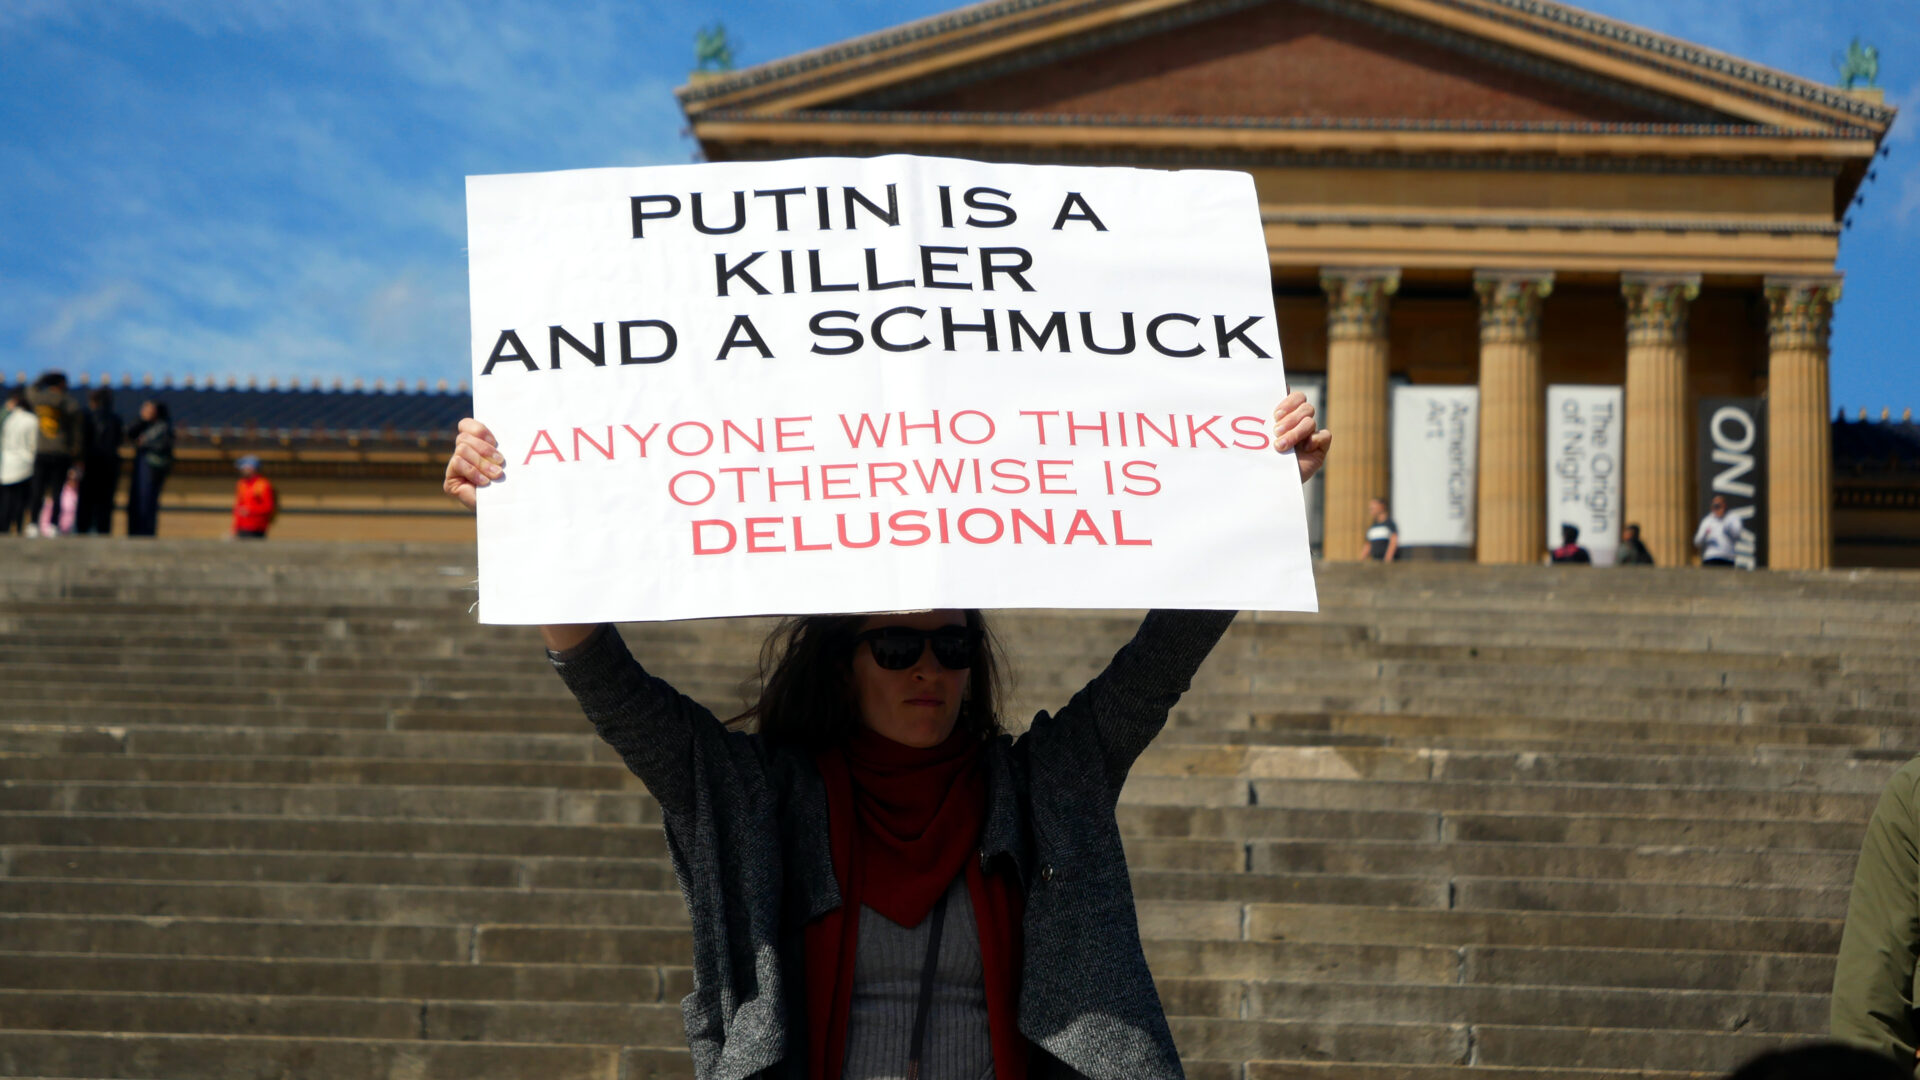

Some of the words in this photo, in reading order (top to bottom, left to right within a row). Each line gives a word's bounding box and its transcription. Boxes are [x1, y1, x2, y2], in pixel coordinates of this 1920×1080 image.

[631, 183, 900, 239] PUTIN
[939, 185, 1017, 229] IS
[1053, 191, 1108, 232] A
[714, 245, 1035, 297] KILLER
[482, 319, 678, 376] AND
[715, 314, 775, 361] A
[809, 305, 1273, 359] SCHMUCK
[524, 416, 814, 465] ANYONE
[839, 409, 995, 450] WHO
[1019, 411, 1270, 451] THINKS
[1426, 400, 1446, 439] Art
[1562, 399, 1586, 425] of
[1592, 401, 1614, 447] The
[1448, 400, 1470, 520] American
[1556, 431, 1586, 503] Night
[1710, 406, 1756, 498] ON
[669, 458, 1076, 507] OTHERWISE
[1105, 460, 1161, 496] IS
[1586, 453, 1615, 534] Origin
[692, 508, 1153, 556] DELUSIONAL
